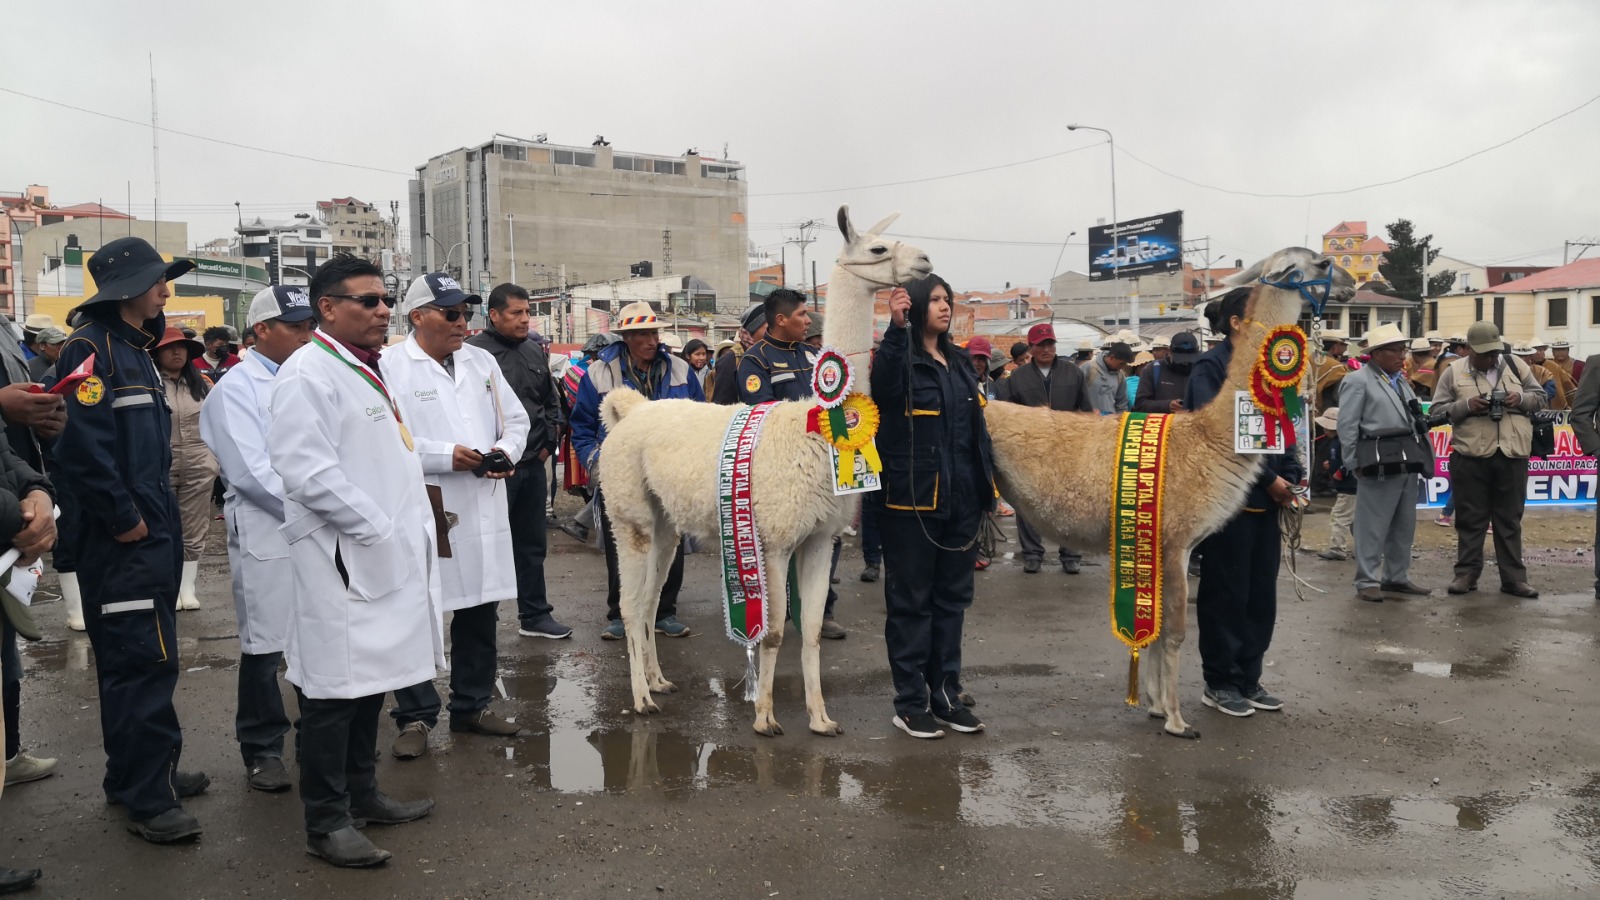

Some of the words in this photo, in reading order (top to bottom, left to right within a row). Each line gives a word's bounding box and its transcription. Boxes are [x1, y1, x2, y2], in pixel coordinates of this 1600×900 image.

[198, 262, 218, 271] Mercantil
[218, 264, 230, 272] Santa
[231, 266, 239, 274] Cruz
[1123, 419, 1145, 462] CAMPEON
[1140, 418, 1163, 469] EXPOFERIA
[720, 451, 737, 496] CAMPEON
[1528, 459, 1572, 471] ROVINCIA
[1120, 465, 1138, 505] JUNIOR
[720, 498, 734, 536] JUNIOR
[735, 498, 750, 513] DE
[1137, 511, 1153, 526] DE
[735, 513, 757, 570] CAMELIDOS
[1136, 529, 1153, 588] CAMELIDOS
[727, 567, 746, 605] HEMBRA
[1120, 545, 1136, 589] HEMBRA
[743, 573, 762, 600] 2023
[1136, 592, 1153, 620] 2023
